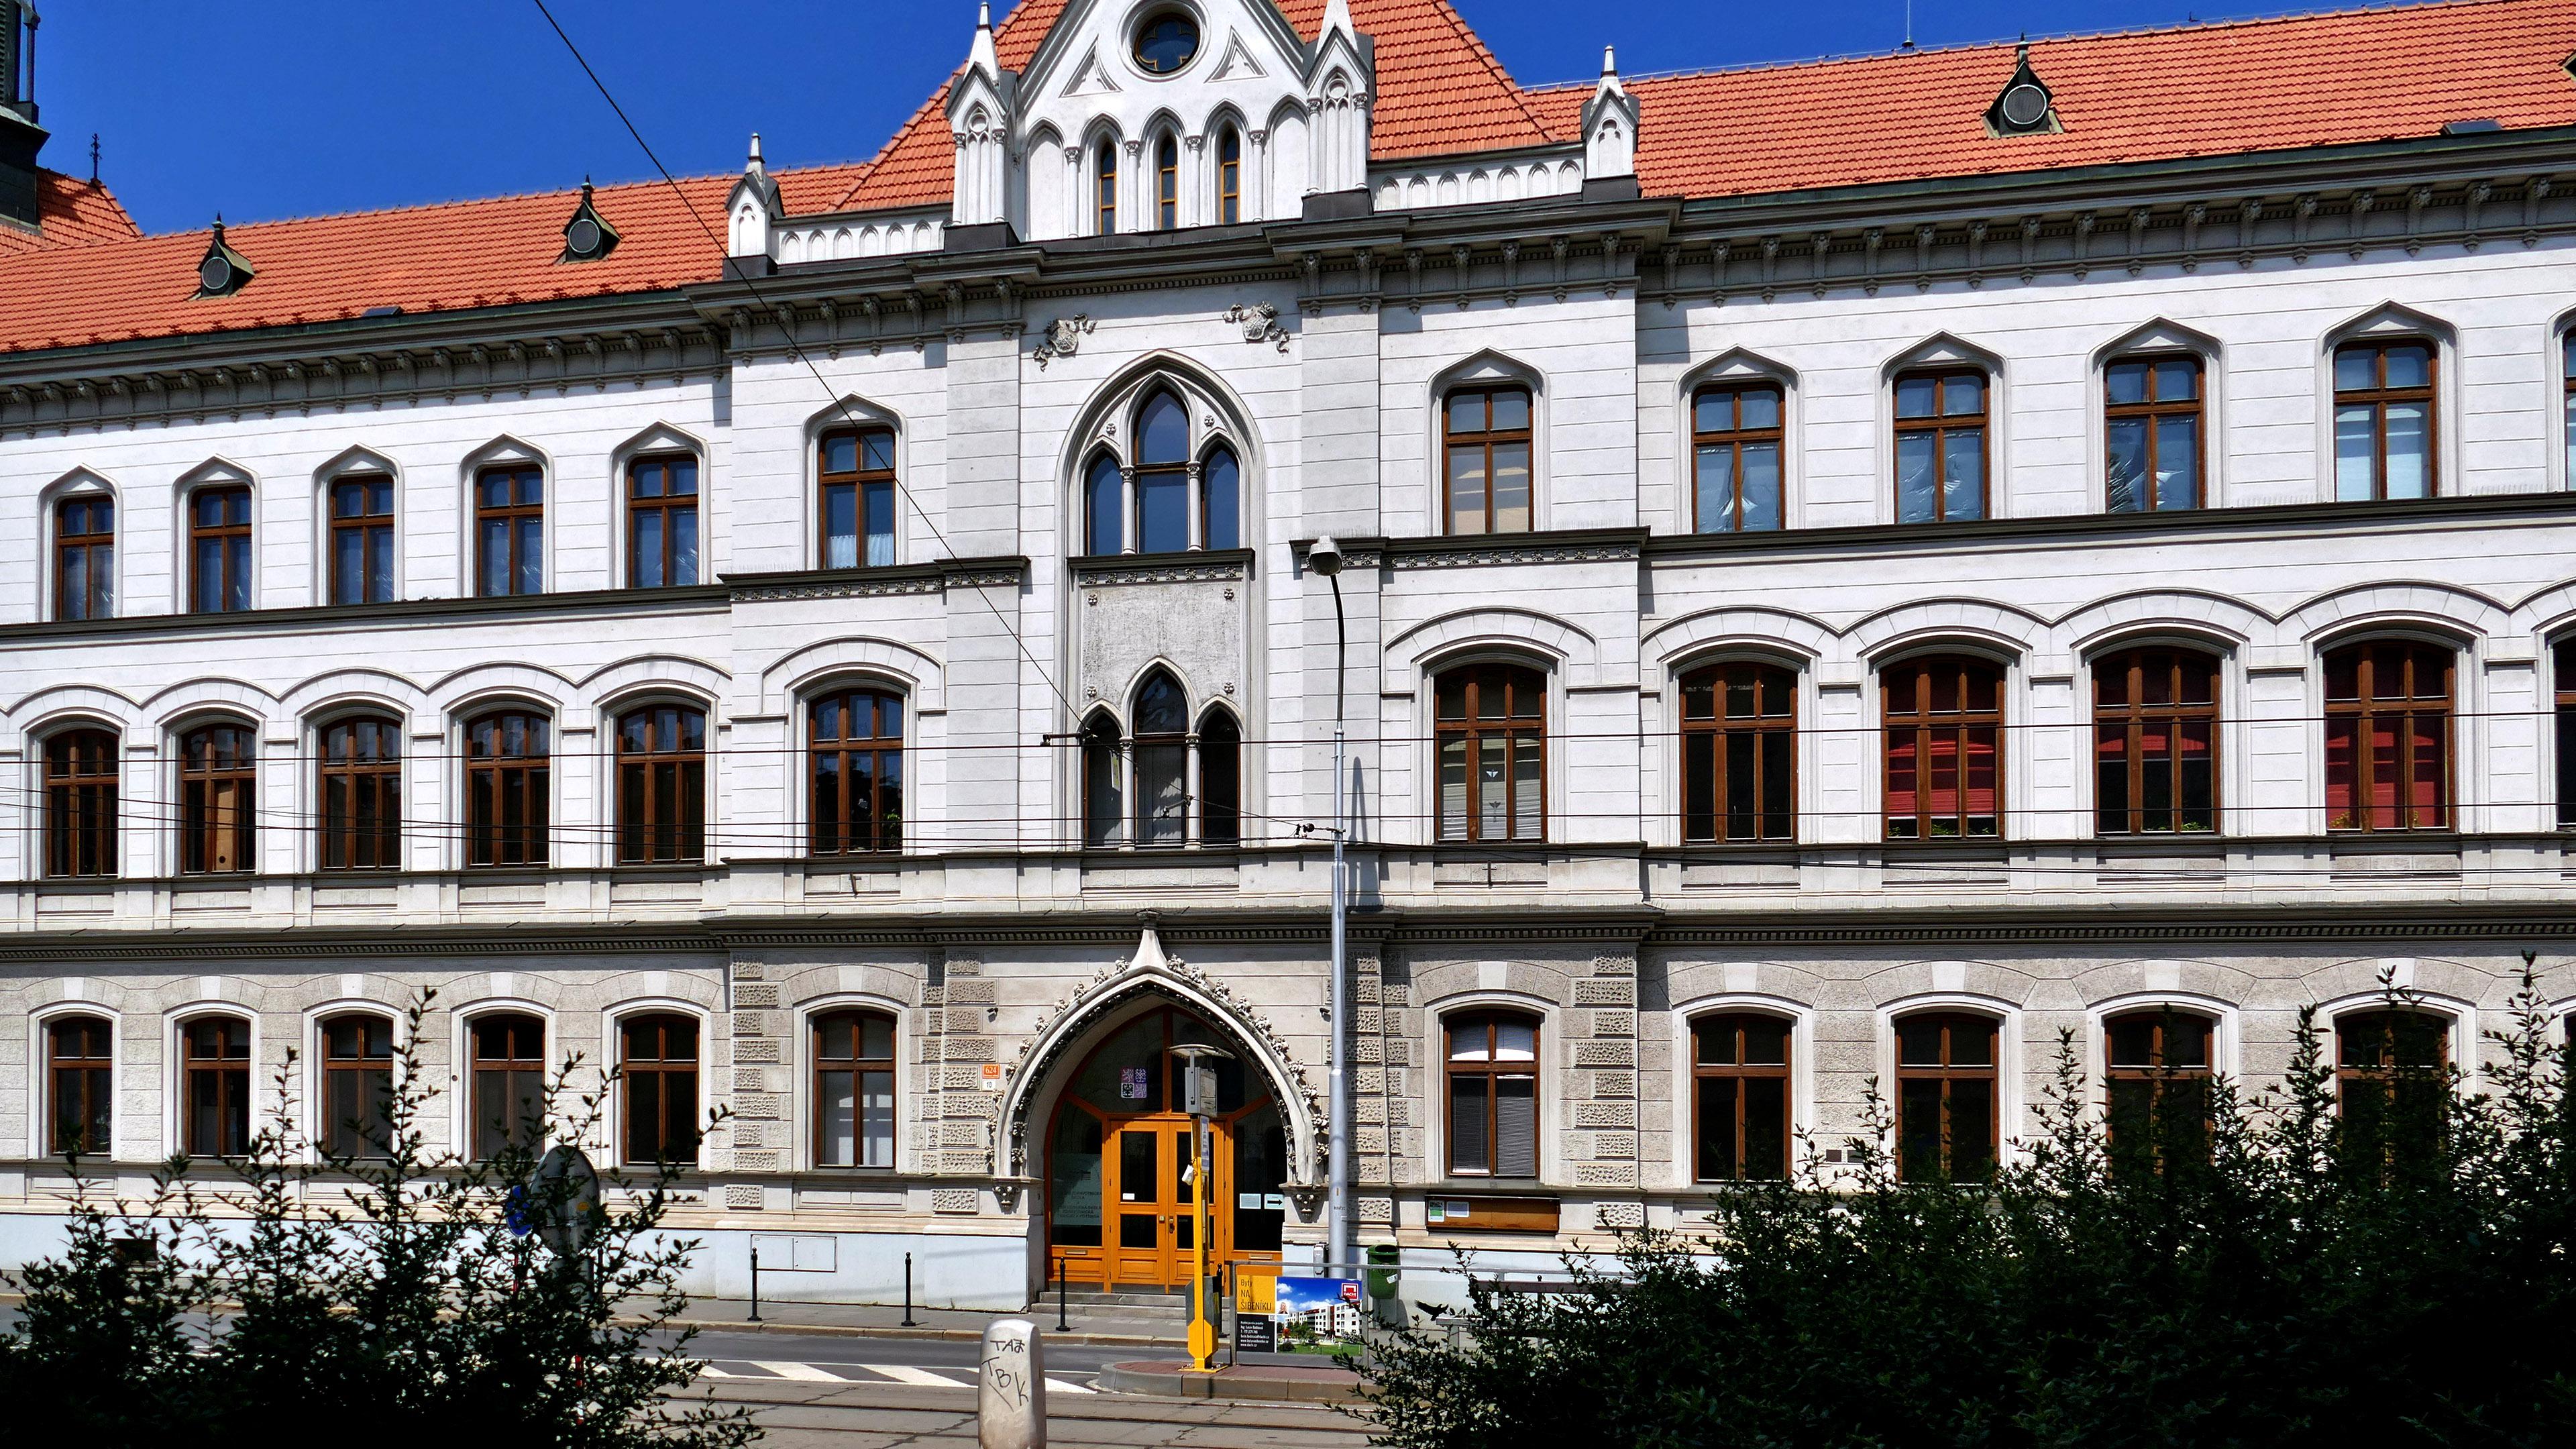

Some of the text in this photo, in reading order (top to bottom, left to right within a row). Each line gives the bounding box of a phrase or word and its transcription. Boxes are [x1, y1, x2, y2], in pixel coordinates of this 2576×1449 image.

[1240, 1279, 1252, 1287] Byty
[1241, 1289, 1250, 1297] NA
[1240, 1299, 1272, 1311] ŠIBENÍKU
